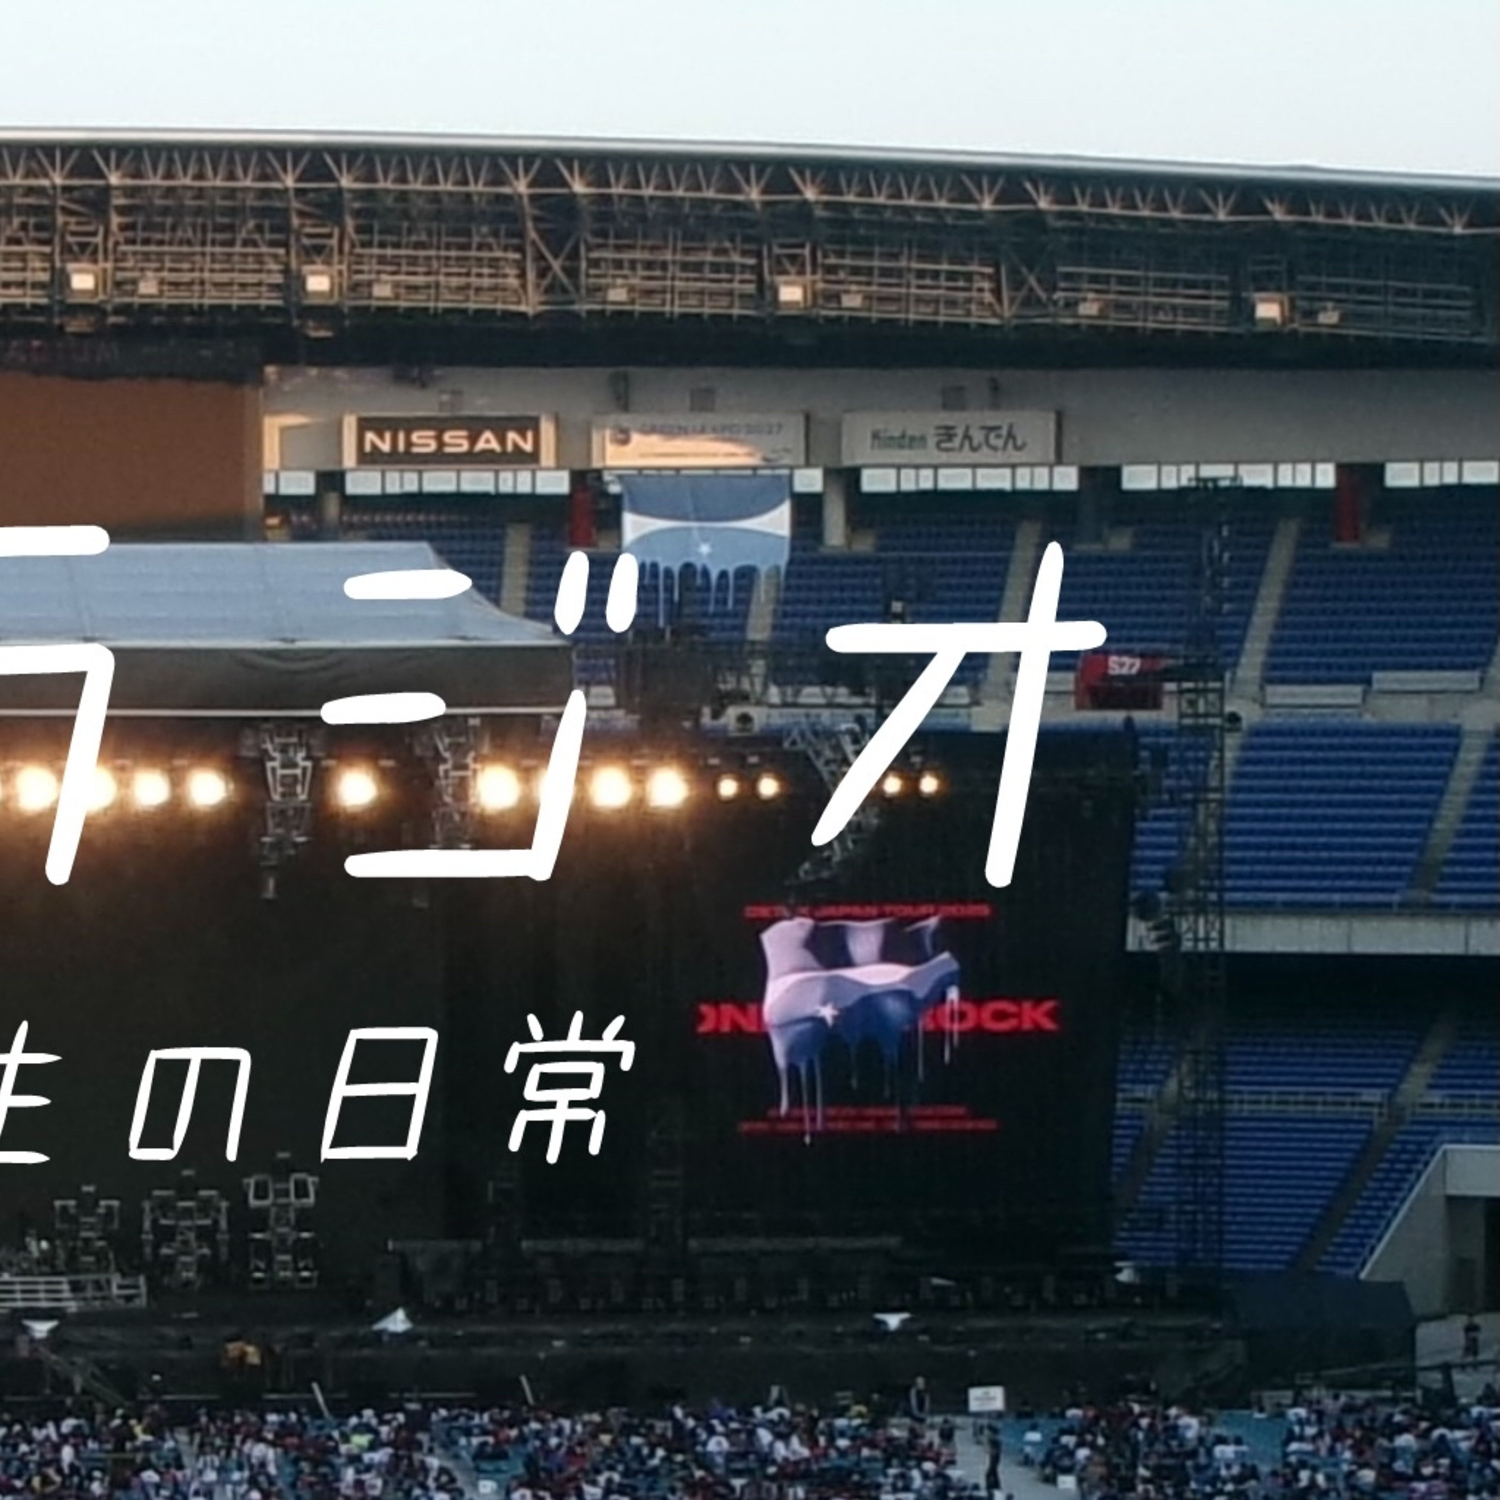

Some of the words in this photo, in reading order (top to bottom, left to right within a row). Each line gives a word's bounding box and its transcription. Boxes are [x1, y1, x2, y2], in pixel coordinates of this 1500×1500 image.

[364, 429, 535, 453] NISSAN
[934, 422, 1028, 453] きんでん
[1107, 656, 1141, 675] S27
